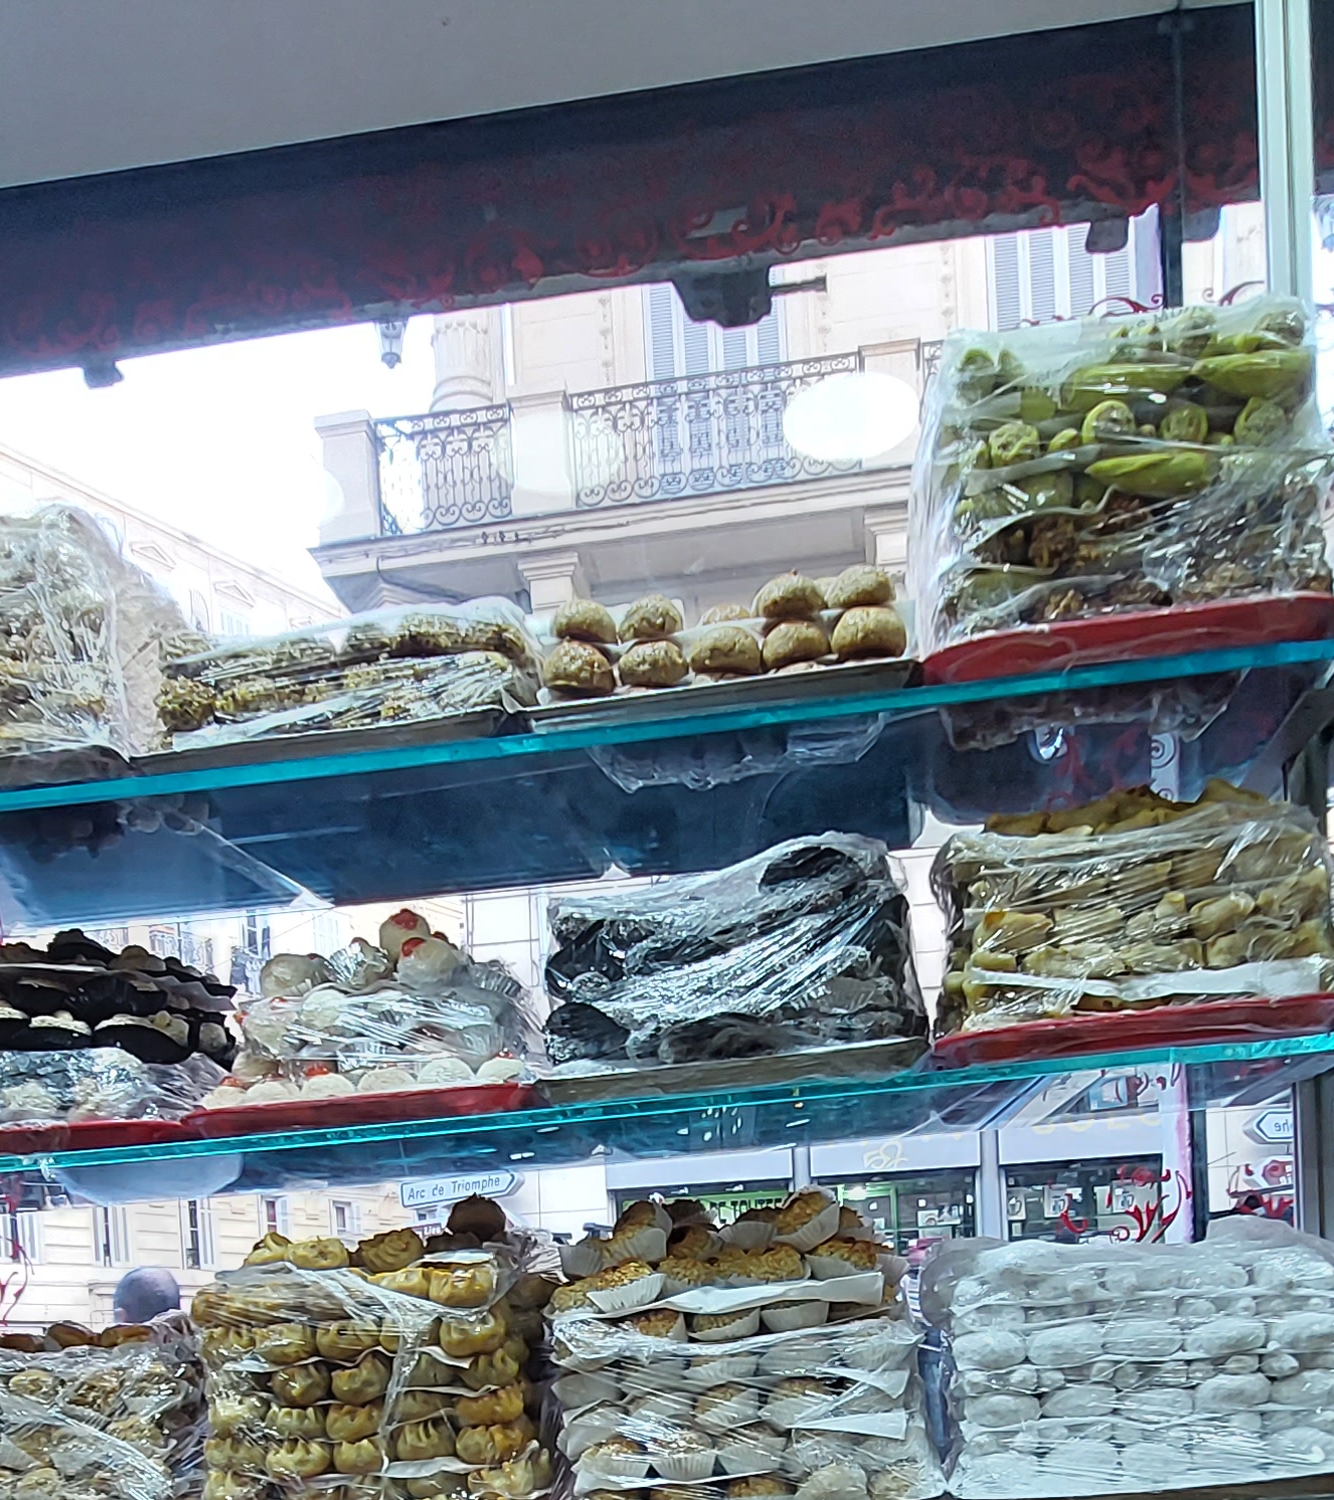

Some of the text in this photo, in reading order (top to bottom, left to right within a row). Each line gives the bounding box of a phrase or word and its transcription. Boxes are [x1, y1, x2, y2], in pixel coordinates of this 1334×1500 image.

[407, 1175, 500, 1201] Arc de Triomphe
